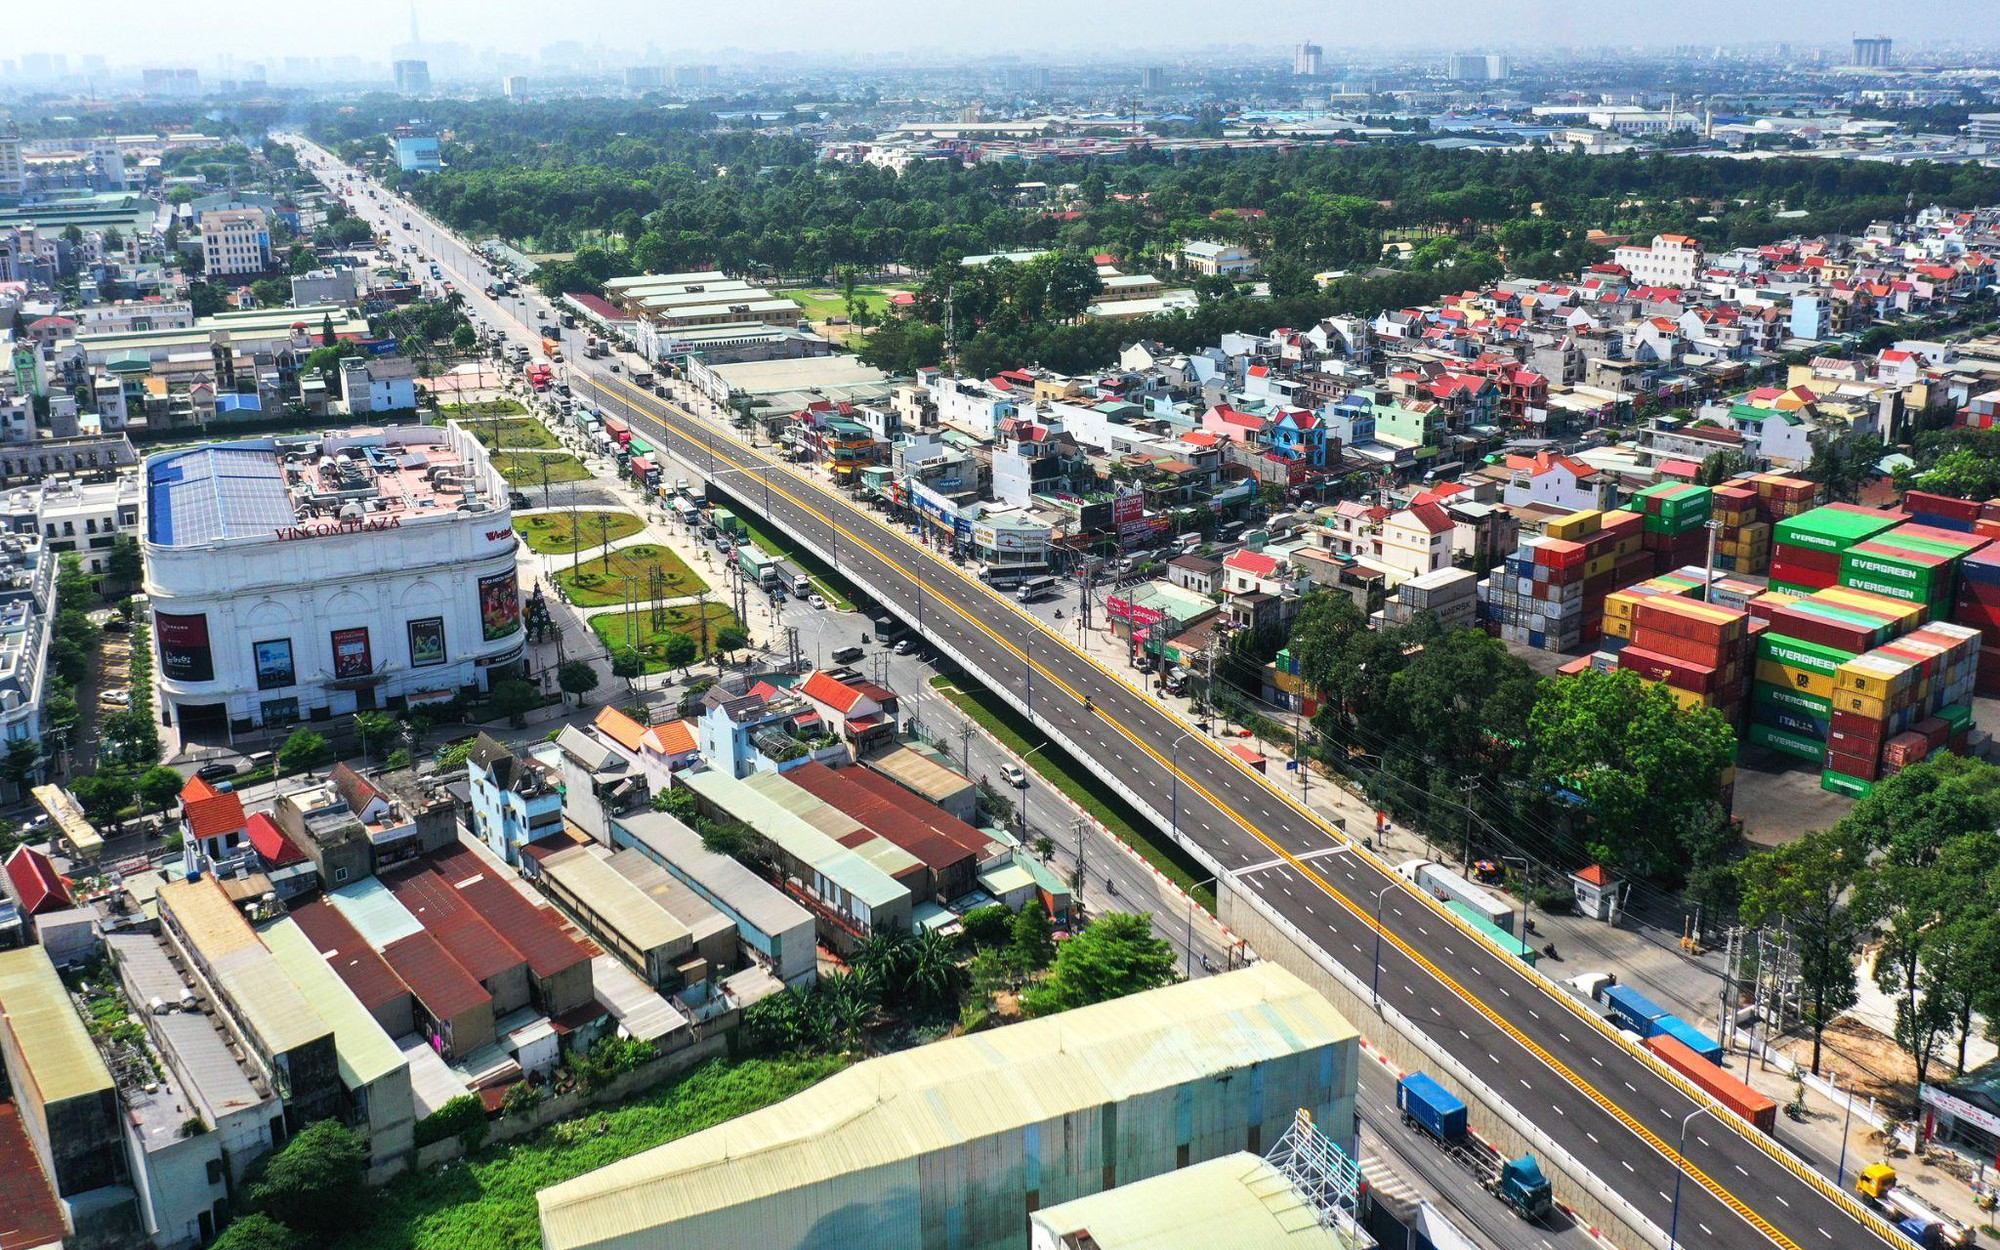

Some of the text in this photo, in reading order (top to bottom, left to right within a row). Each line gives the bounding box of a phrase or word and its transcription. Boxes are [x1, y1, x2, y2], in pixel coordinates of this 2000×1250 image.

[275, 515, 401, 540] VINCOM PLAZA
[1790, 532, 1837, 547] EVERGREEN
[1851, 558, 1916, 579] EVERGREEN
[1848, 578, 1914, 599] EVERGREEN
[1770, 646, 1839, 670] EVERGREEN
[1772, 691, 1827, 712] EVERGREEN
[1767, 734, 1819, 754] EVERGREEN
